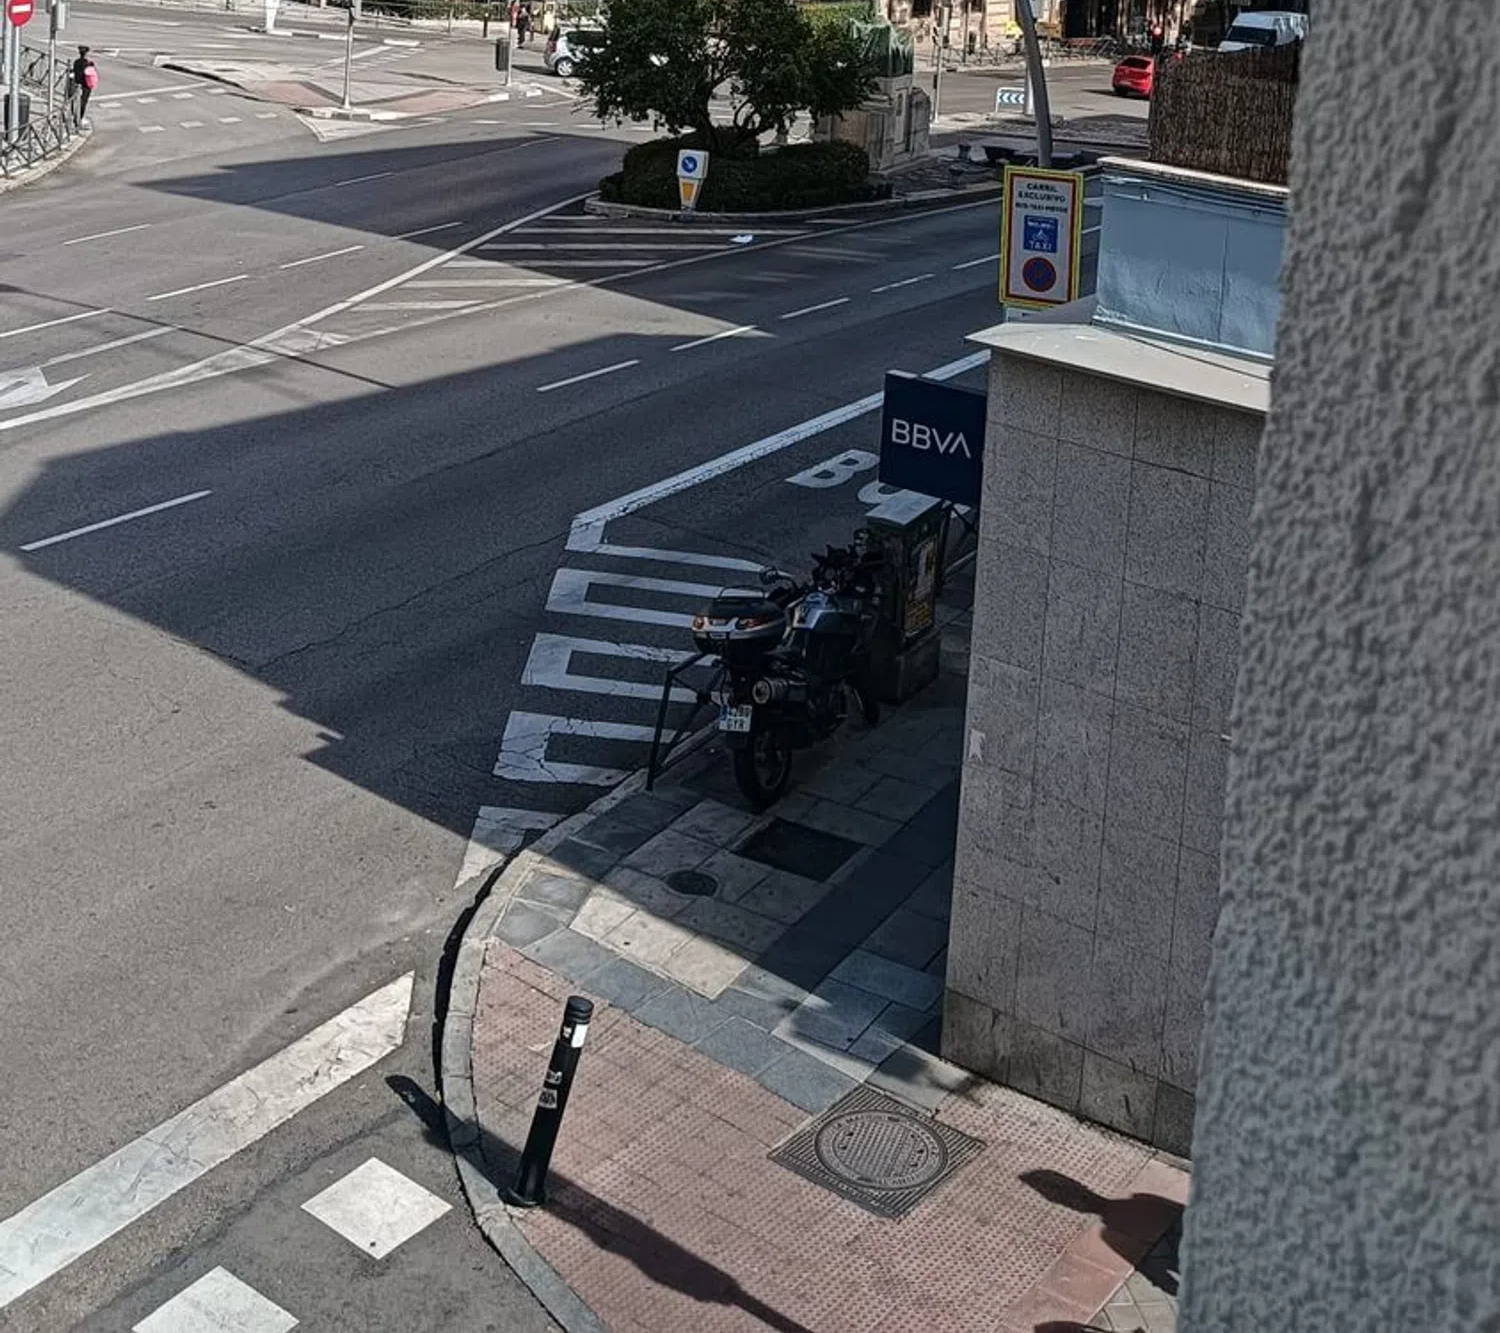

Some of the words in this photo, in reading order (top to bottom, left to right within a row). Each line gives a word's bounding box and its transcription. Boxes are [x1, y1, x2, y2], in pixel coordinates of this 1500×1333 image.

[1027, 183, 1057, 193] CARRIL
[1018, 191, 1066, 203] EXCLUSIVO
[1029, 240, 1052, 251] TAXI
[891, 418, 971, 460] BBVA
